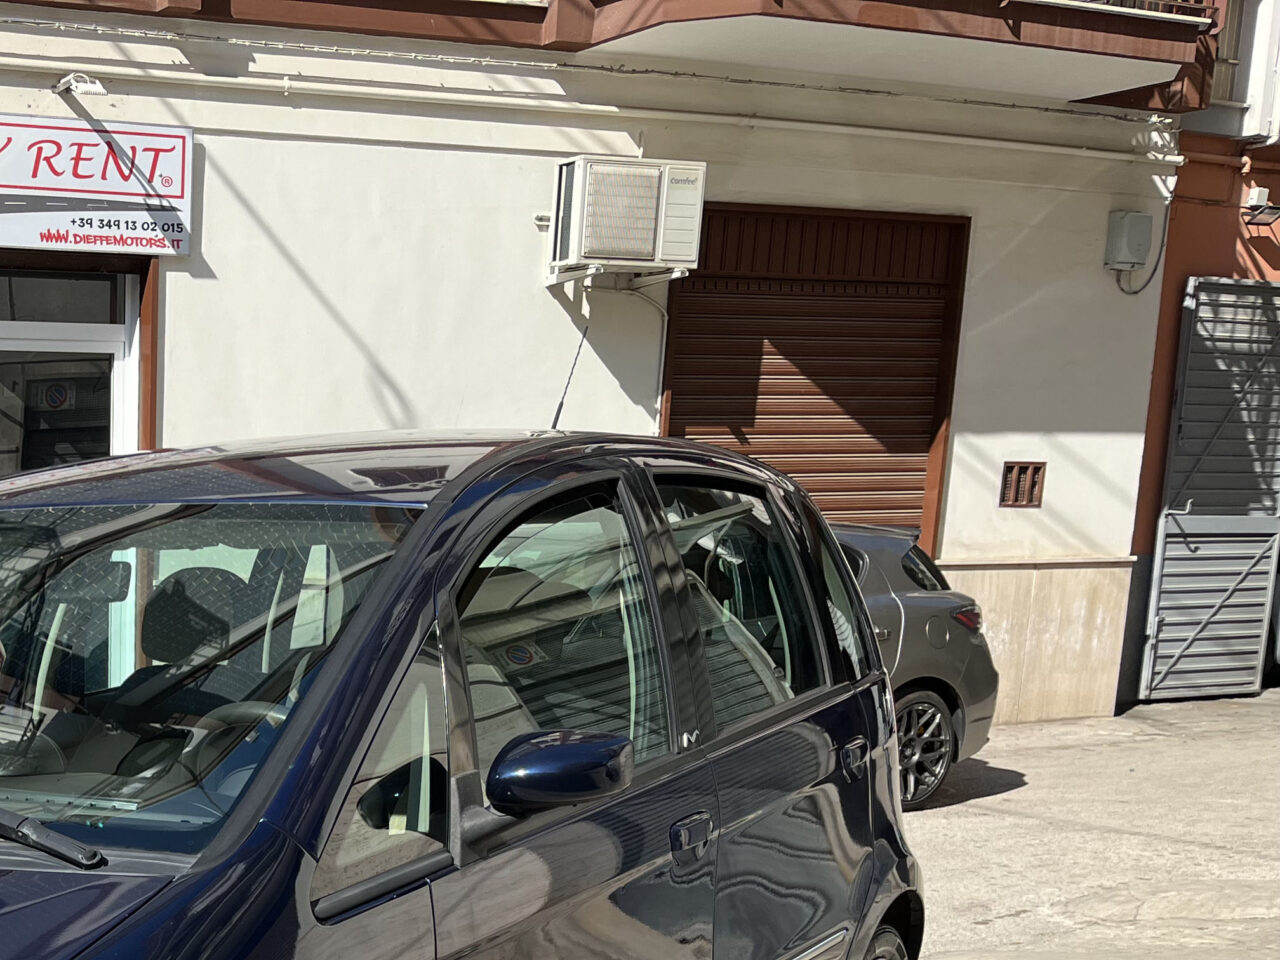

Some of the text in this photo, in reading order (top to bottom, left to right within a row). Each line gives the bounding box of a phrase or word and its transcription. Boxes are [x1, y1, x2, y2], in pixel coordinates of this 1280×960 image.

[70, 217, 184, 234] +39 349 13 02 015
[39, 228, 184, 250] WWW.DIEFFEMOTORS.IT
